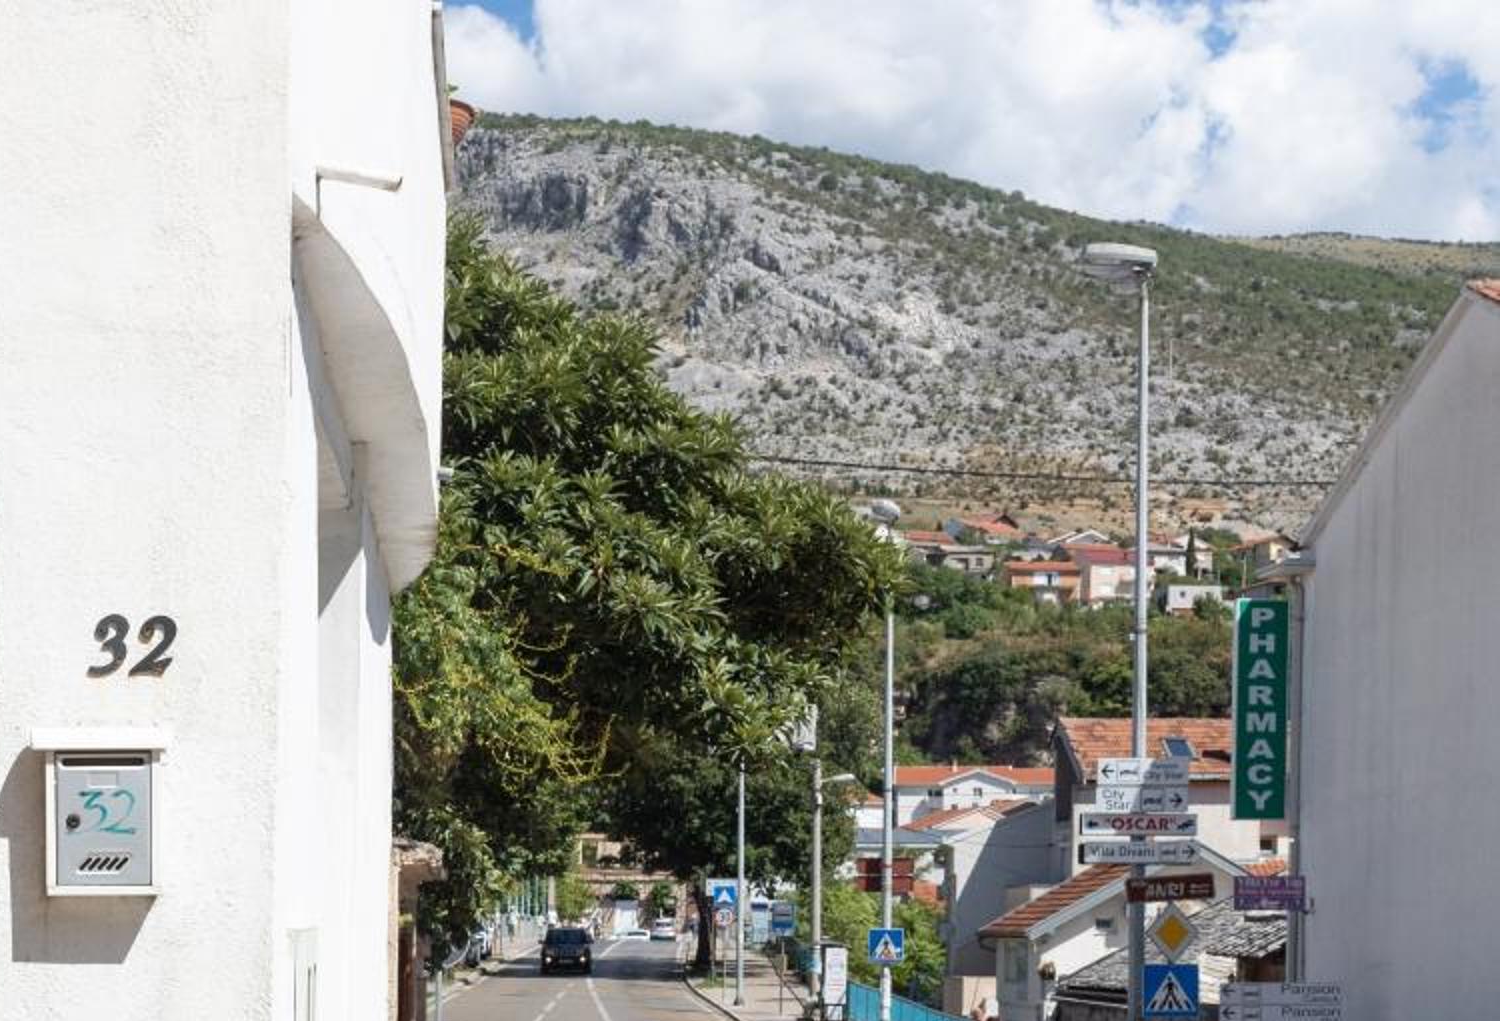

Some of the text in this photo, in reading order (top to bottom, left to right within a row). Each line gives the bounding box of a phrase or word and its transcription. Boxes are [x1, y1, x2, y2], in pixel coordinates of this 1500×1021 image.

[86, 613, 177, 679] 32
[1246, 608, 1276, 811] PHARMACY
[74, 788, 137, 835] 32
[1102, 789, 1125, 801] City
[1105, 799, 1131, 811] Star
